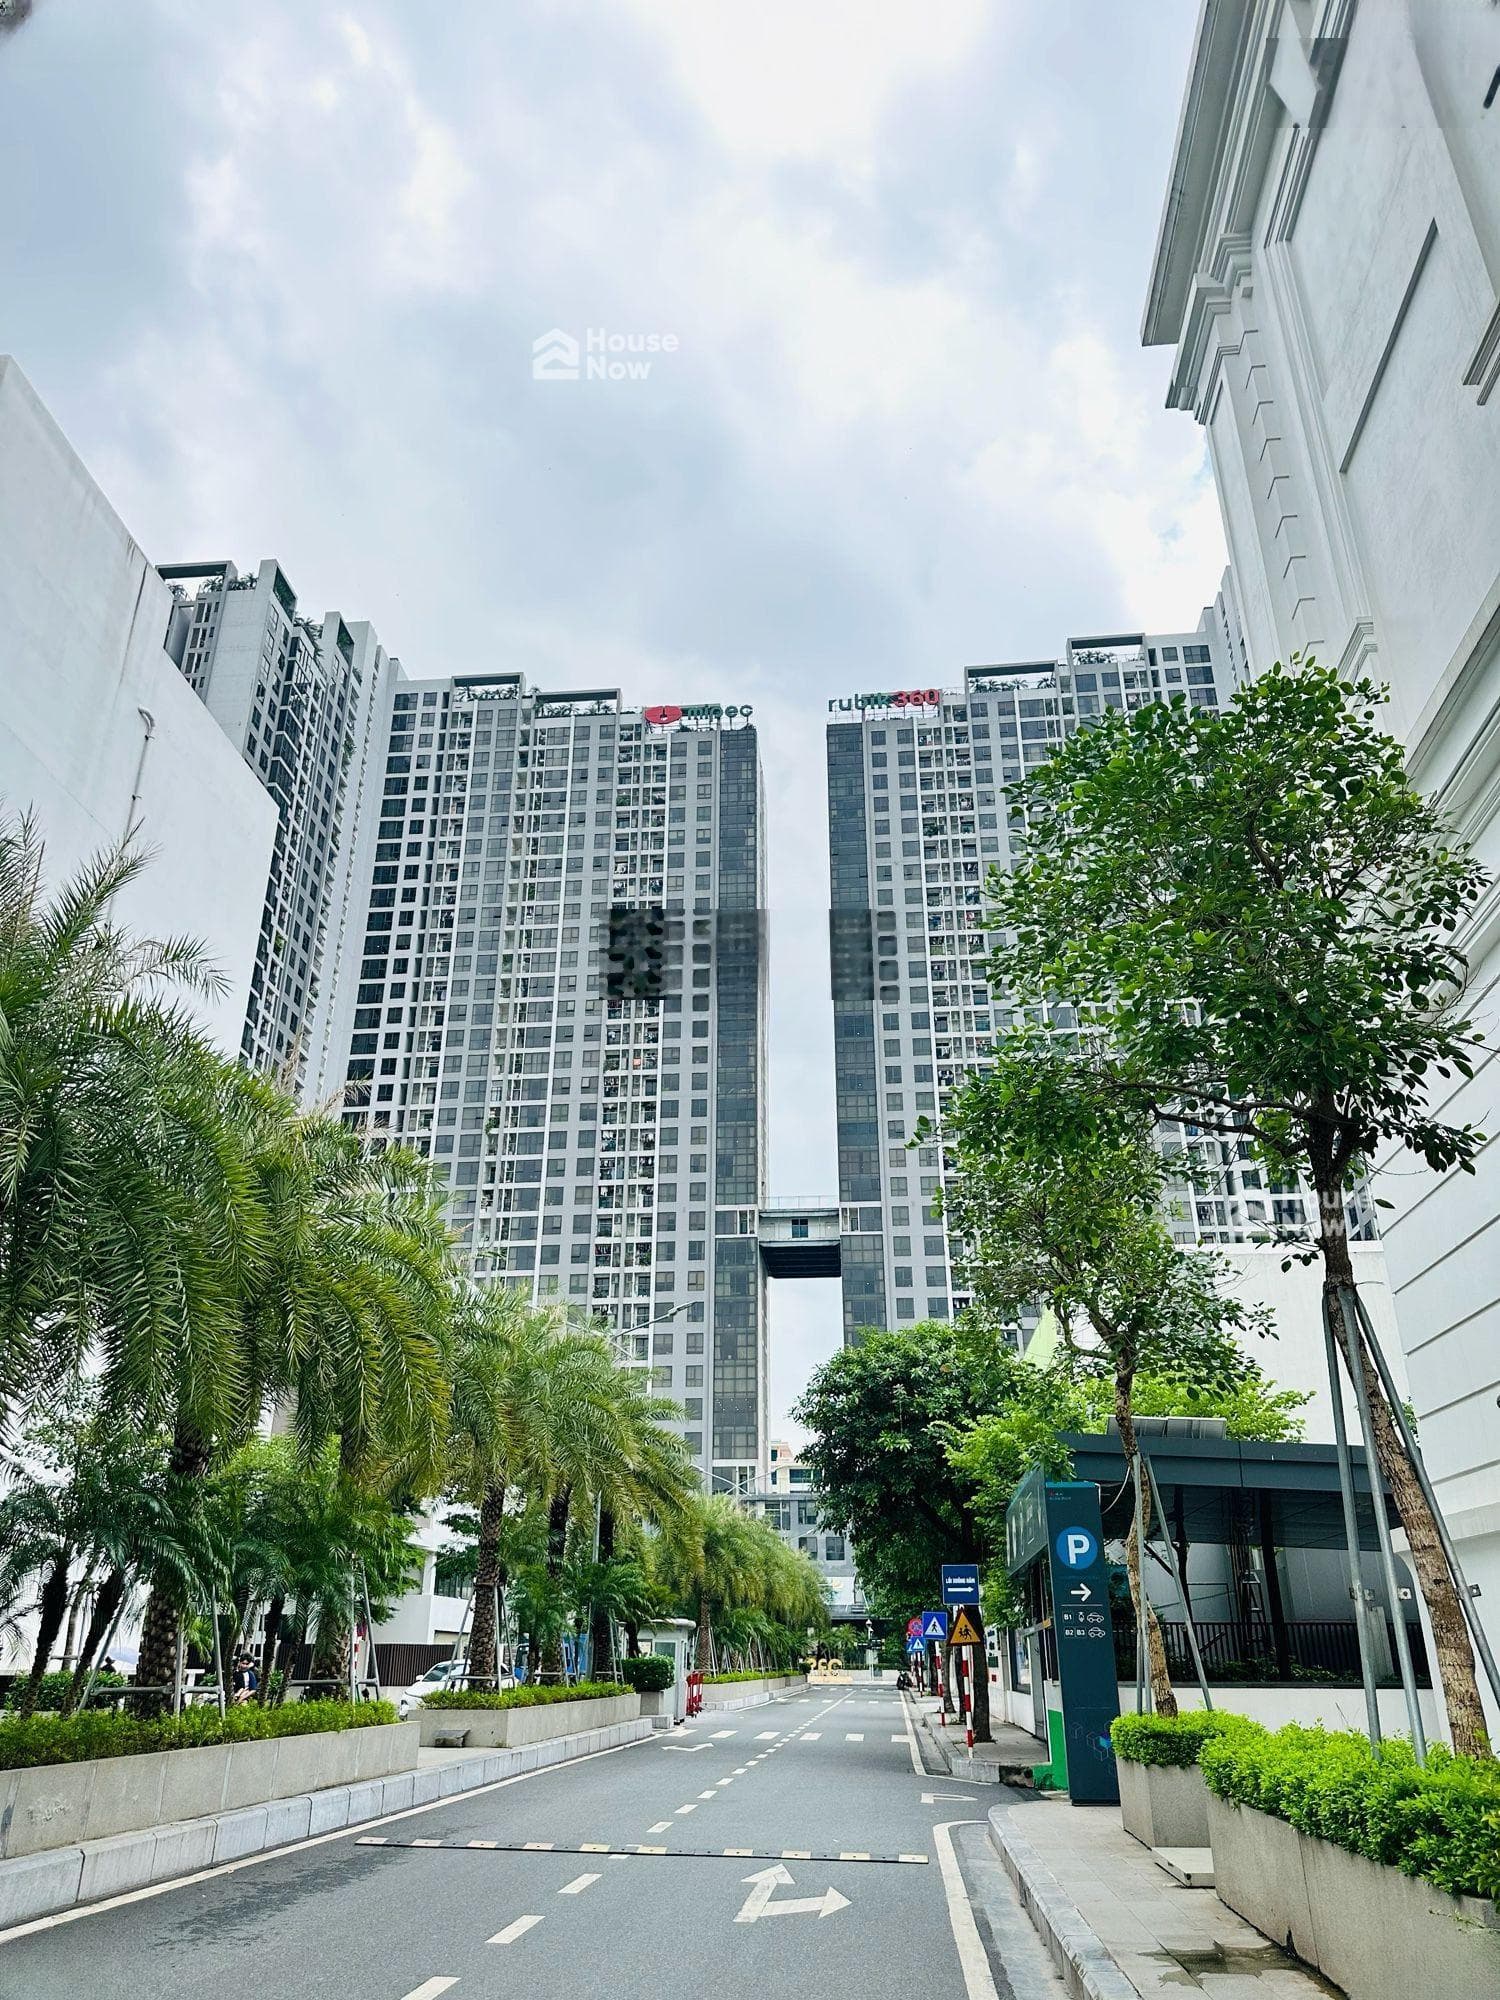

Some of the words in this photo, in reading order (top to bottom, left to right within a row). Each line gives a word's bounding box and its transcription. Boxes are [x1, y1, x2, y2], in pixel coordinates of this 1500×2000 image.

[828, 692, 892, 712] rubik
[893, 688, 940, 708] 360
[687, 704, 753, 722] mipec
[1067, 1534, 1090, 1565] P
